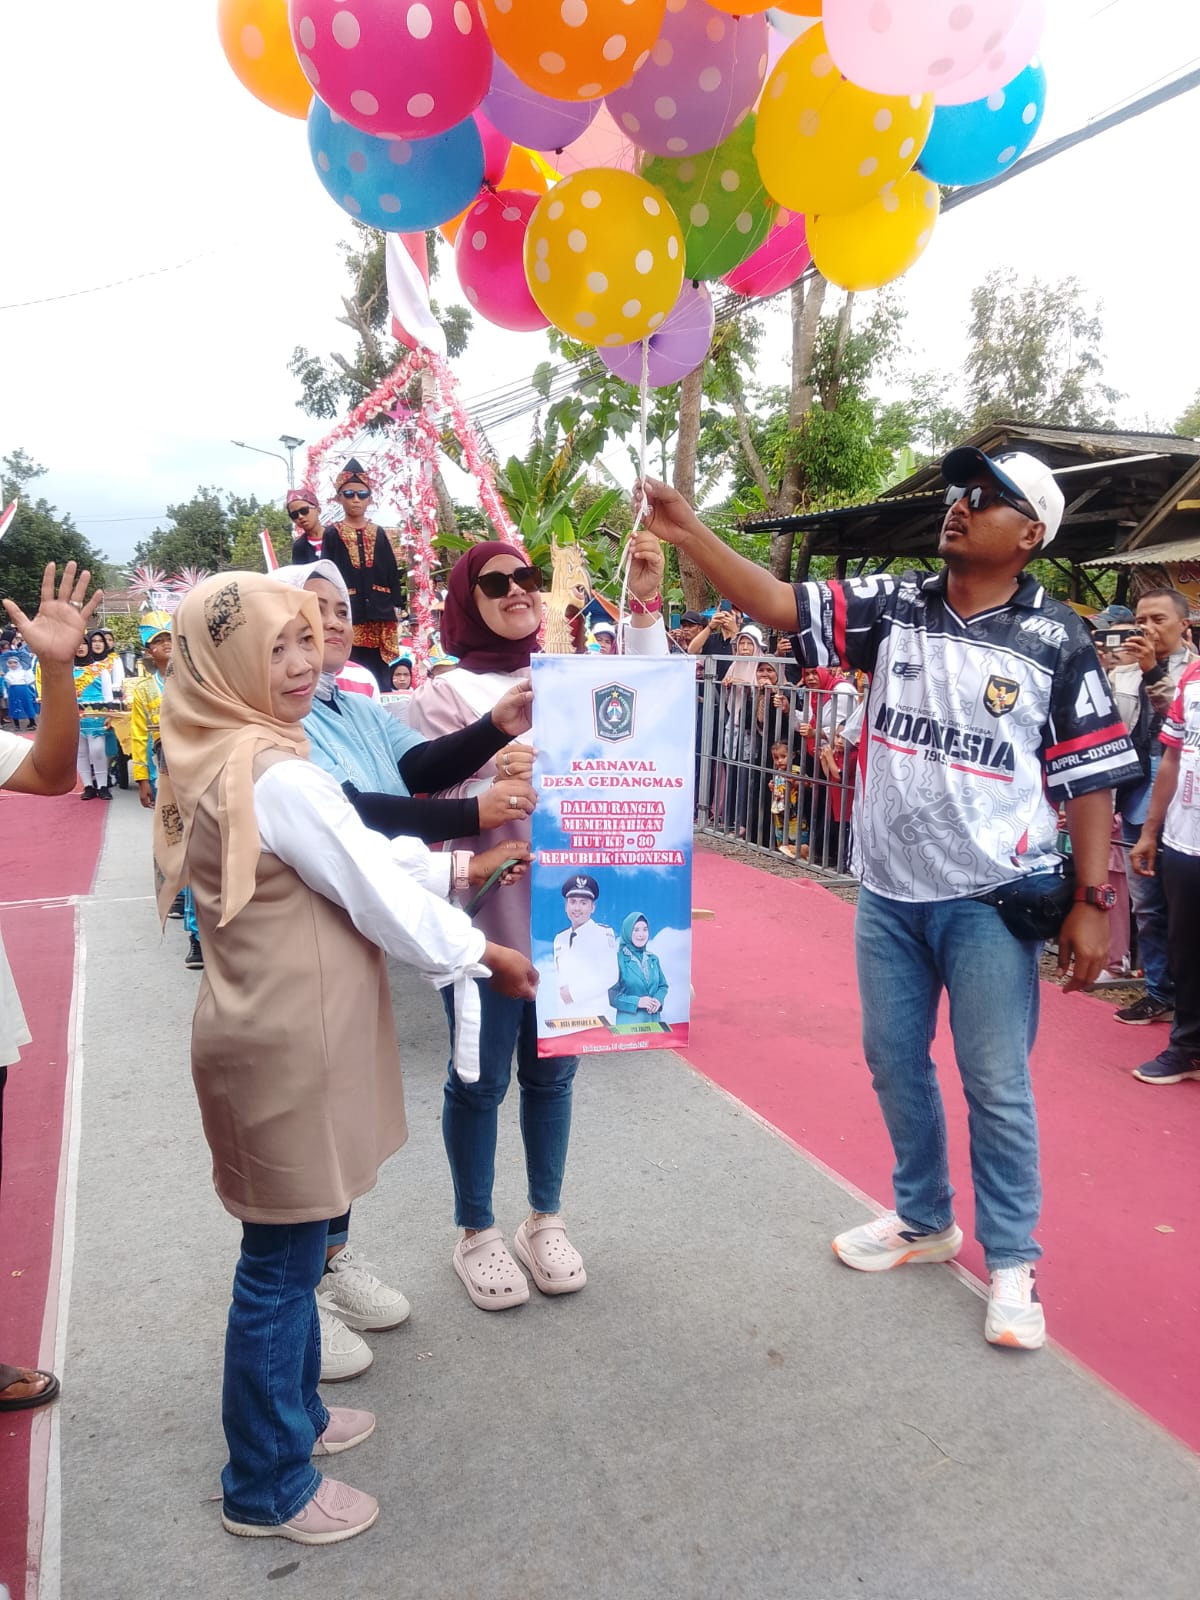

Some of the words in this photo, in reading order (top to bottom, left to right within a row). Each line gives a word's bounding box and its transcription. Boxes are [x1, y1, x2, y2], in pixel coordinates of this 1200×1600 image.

[1074, 670, 1112, 718] 4
[572, 761, 656, 772] KARNAVAL
[543, 777, 585, 787] DESA
[588, 777, 684, 788] GEDANGMAS
[562, 801, 608, 815] DALAM
[610, 801, 665, 815] RANGKA
[562, 818, 663, 831] MEMERIAHKAN
[571, 835, 602, 848] HUT
[602, 835, 624, 848] KE
[637, 834, 655, 848] 80
[540, 851, 612, 864] REPUBLIK
[613, 851, 684, 864] INDONESIA
